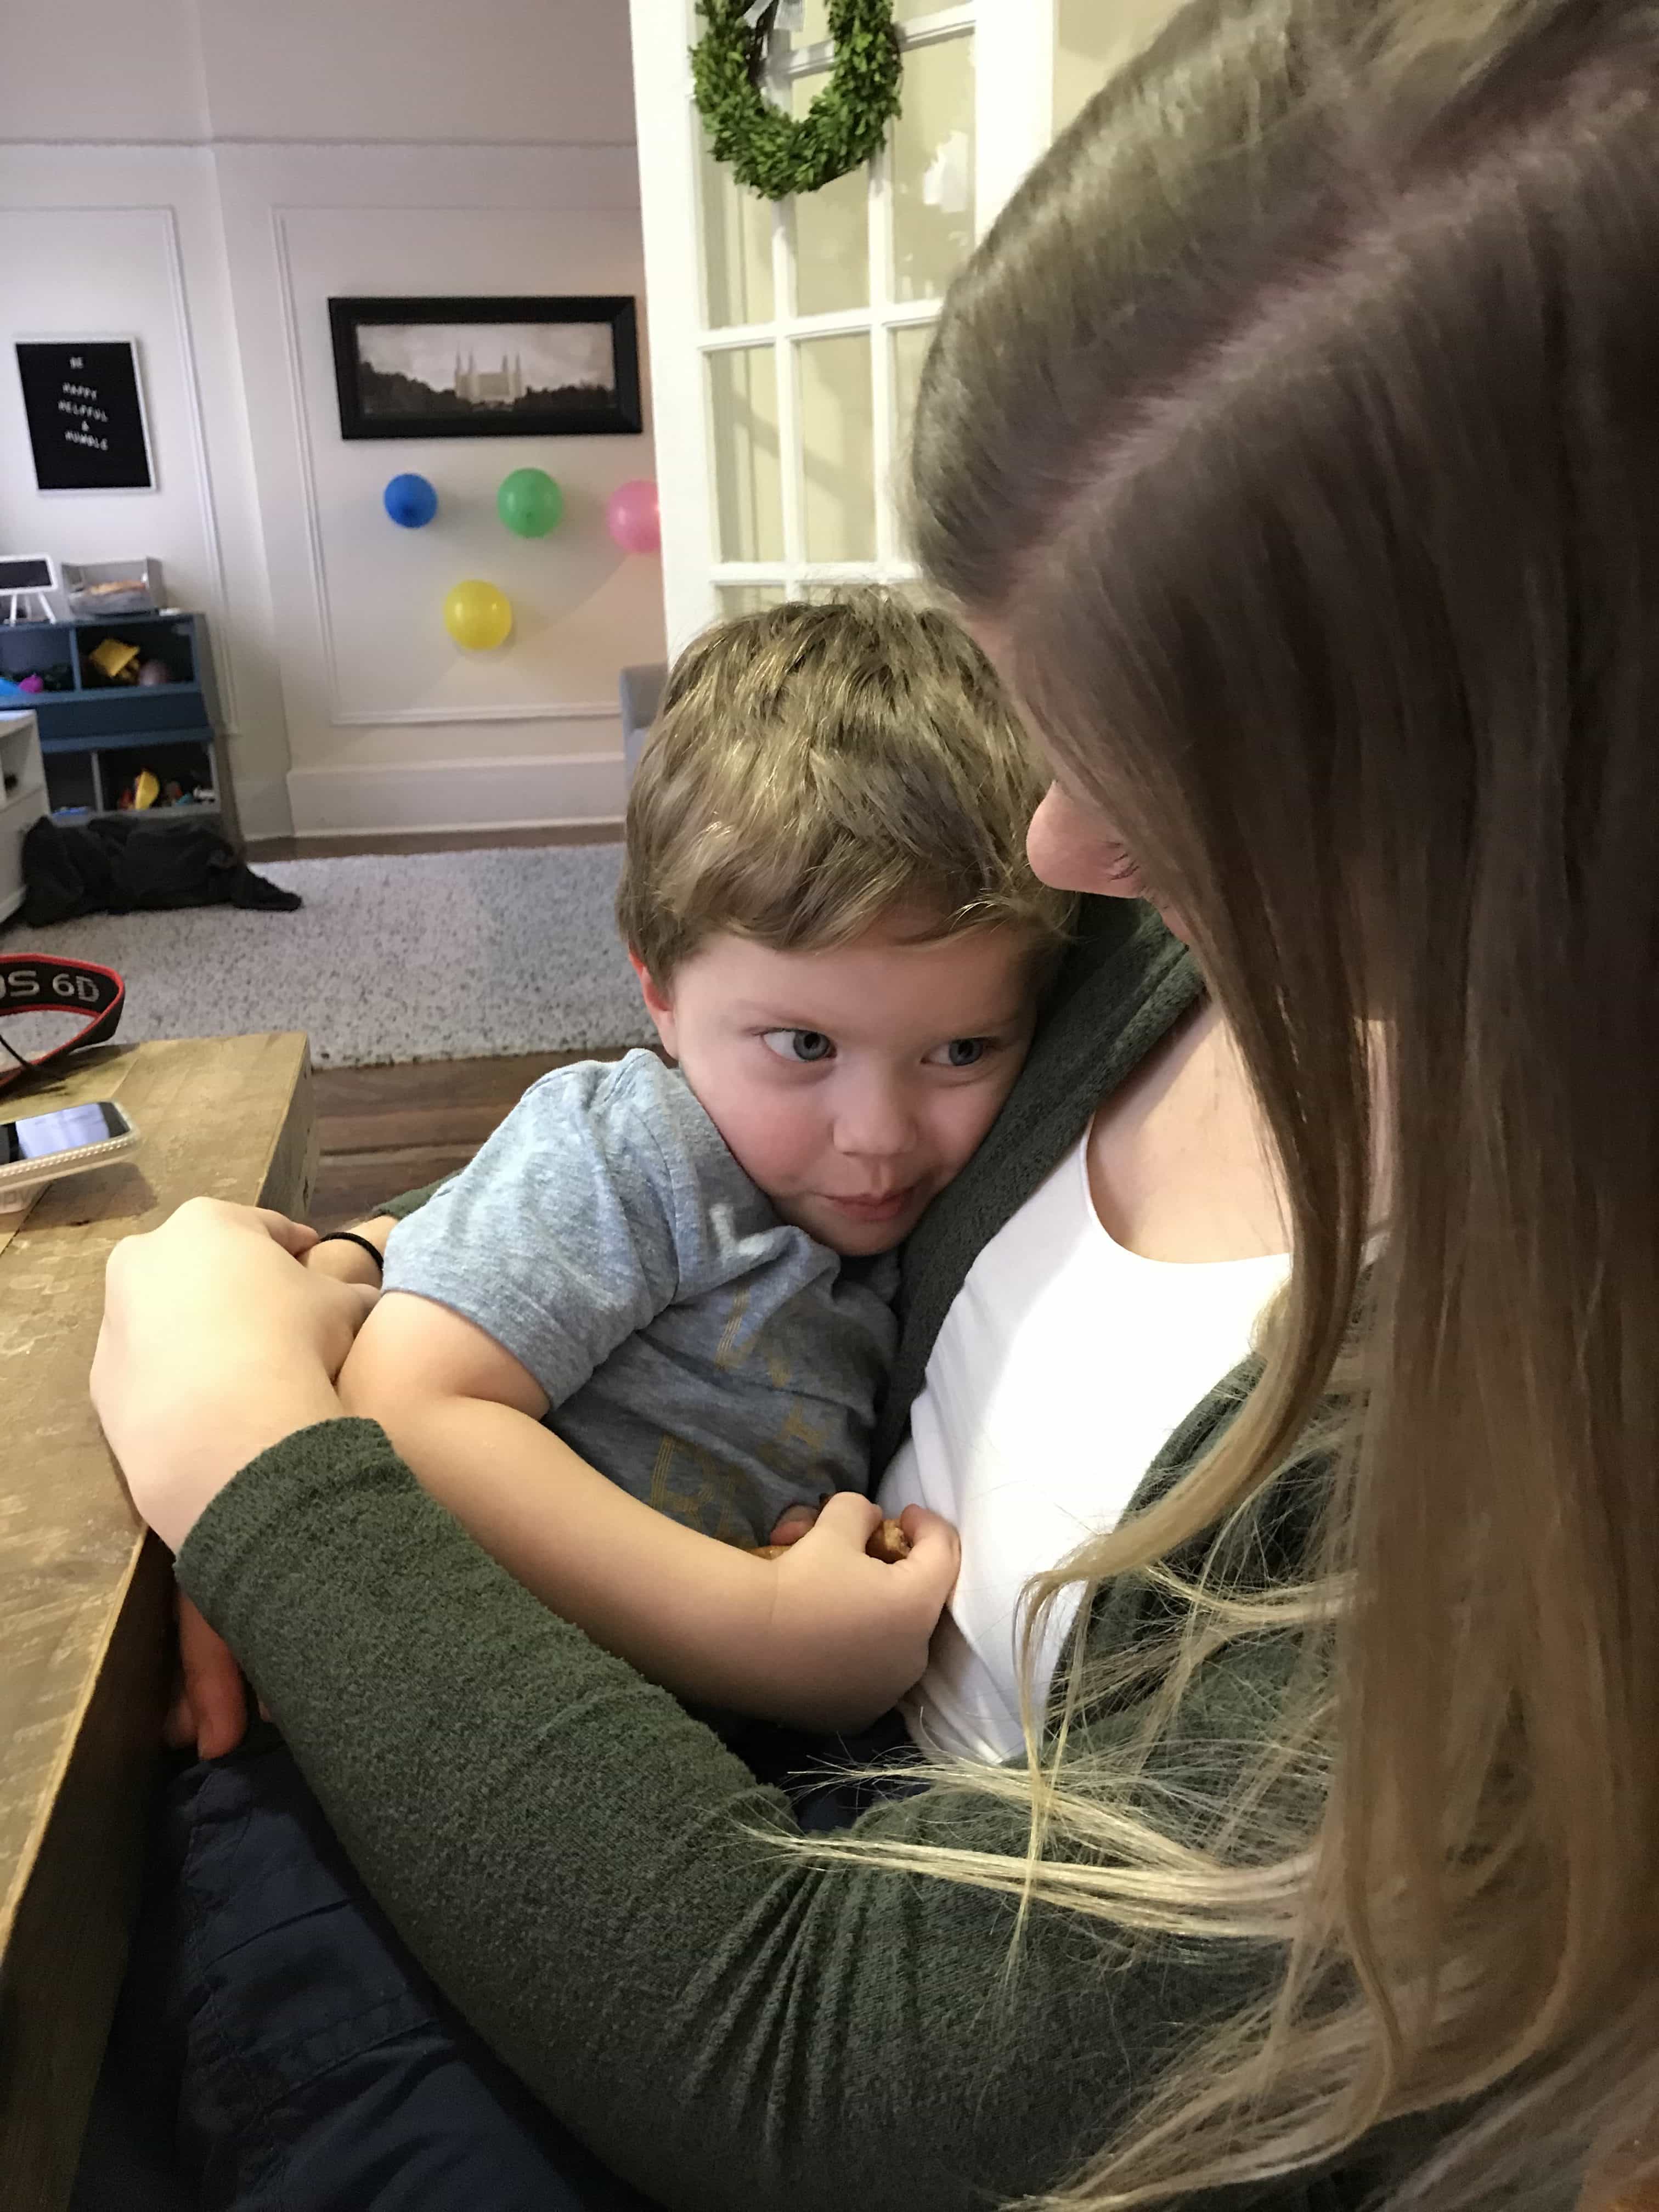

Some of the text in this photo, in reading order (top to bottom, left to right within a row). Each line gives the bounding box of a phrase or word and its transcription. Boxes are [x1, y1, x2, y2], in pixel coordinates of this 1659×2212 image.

[70, 357, 83, 369] BE
[62, 382, 97, 400] HAPPY
[58, 400, 108, 422] HELPFUL
[65, 431, 108, 450] HUMBLE
[53, 973, 100, 1002] 6D
